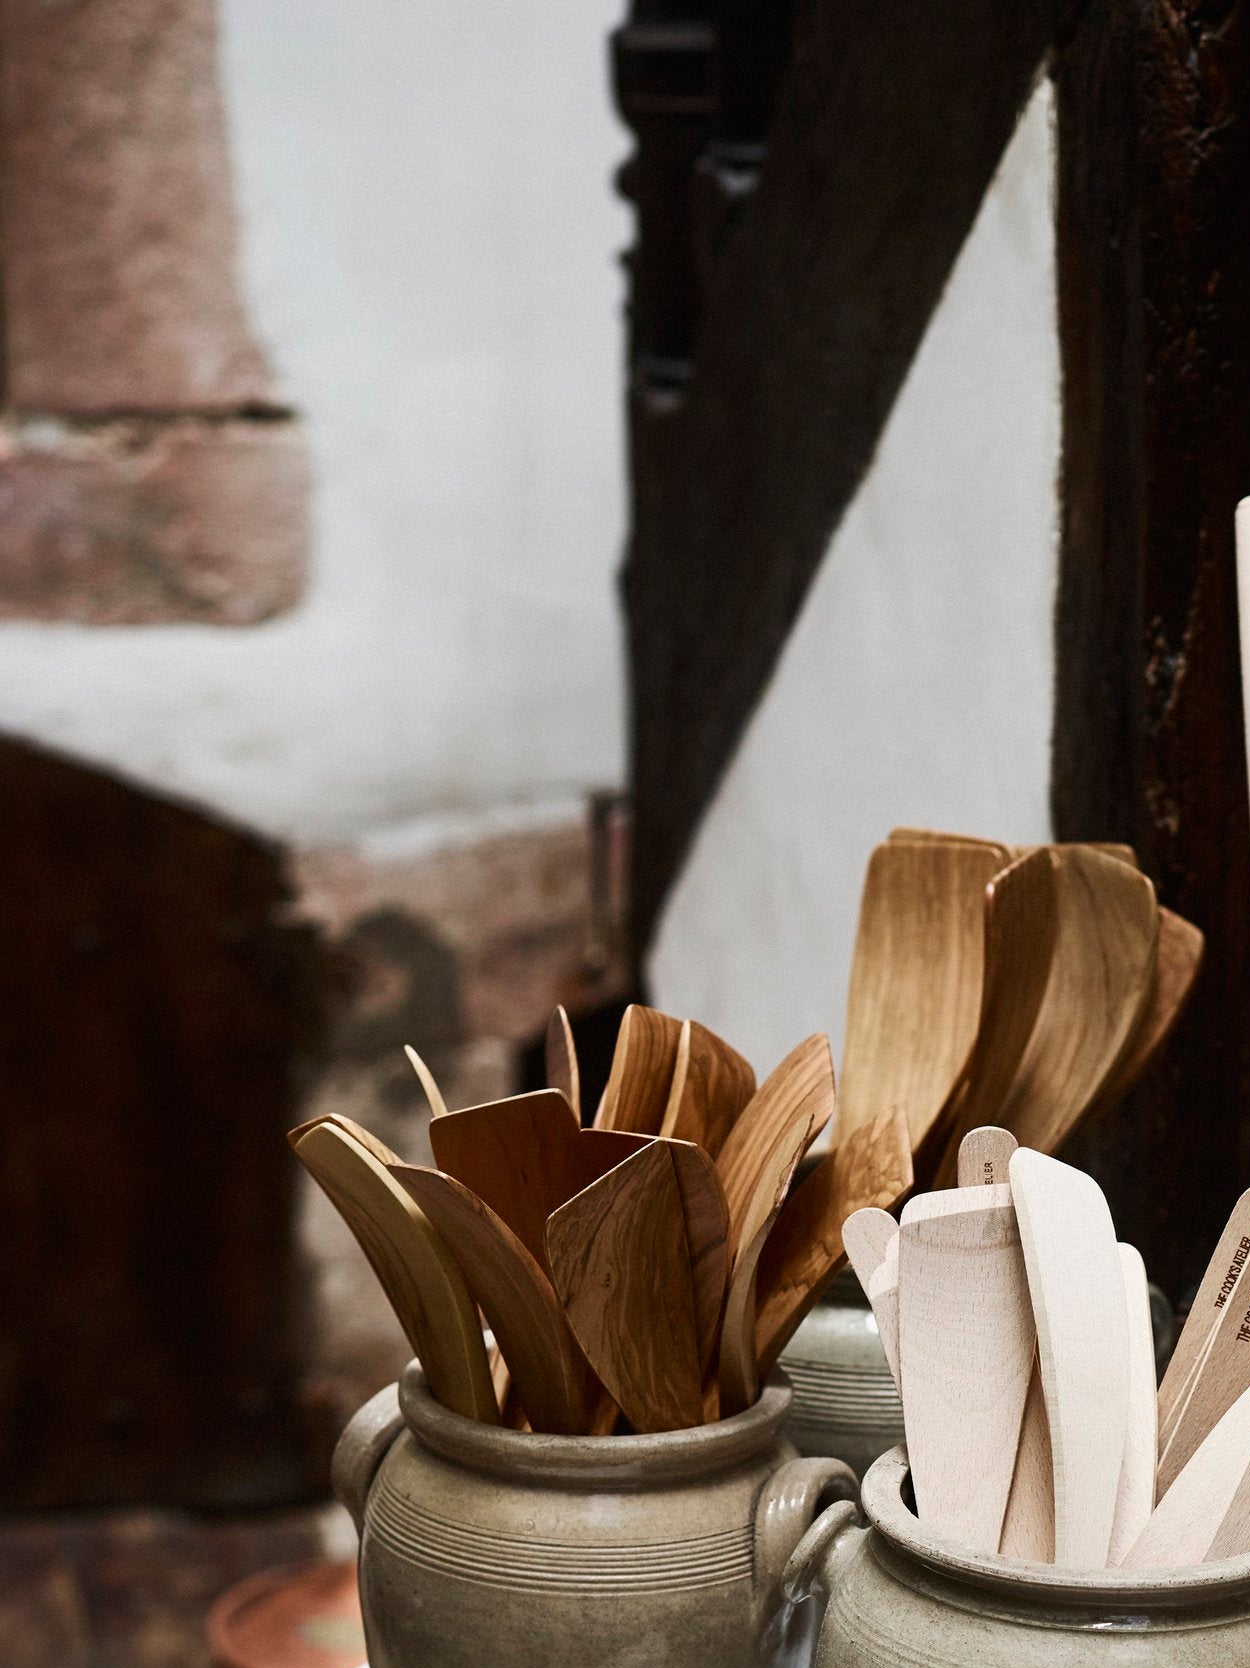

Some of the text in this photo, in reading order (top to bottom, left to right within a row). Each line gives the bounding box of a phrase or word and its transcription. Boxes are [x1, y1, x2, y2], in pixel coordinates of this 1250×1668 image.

[984, 1161, 994, 1185] ELIER
[1214, 1292, 1227, 1309] THE
[1221, 1265, 1241, 1295] COOK'S
